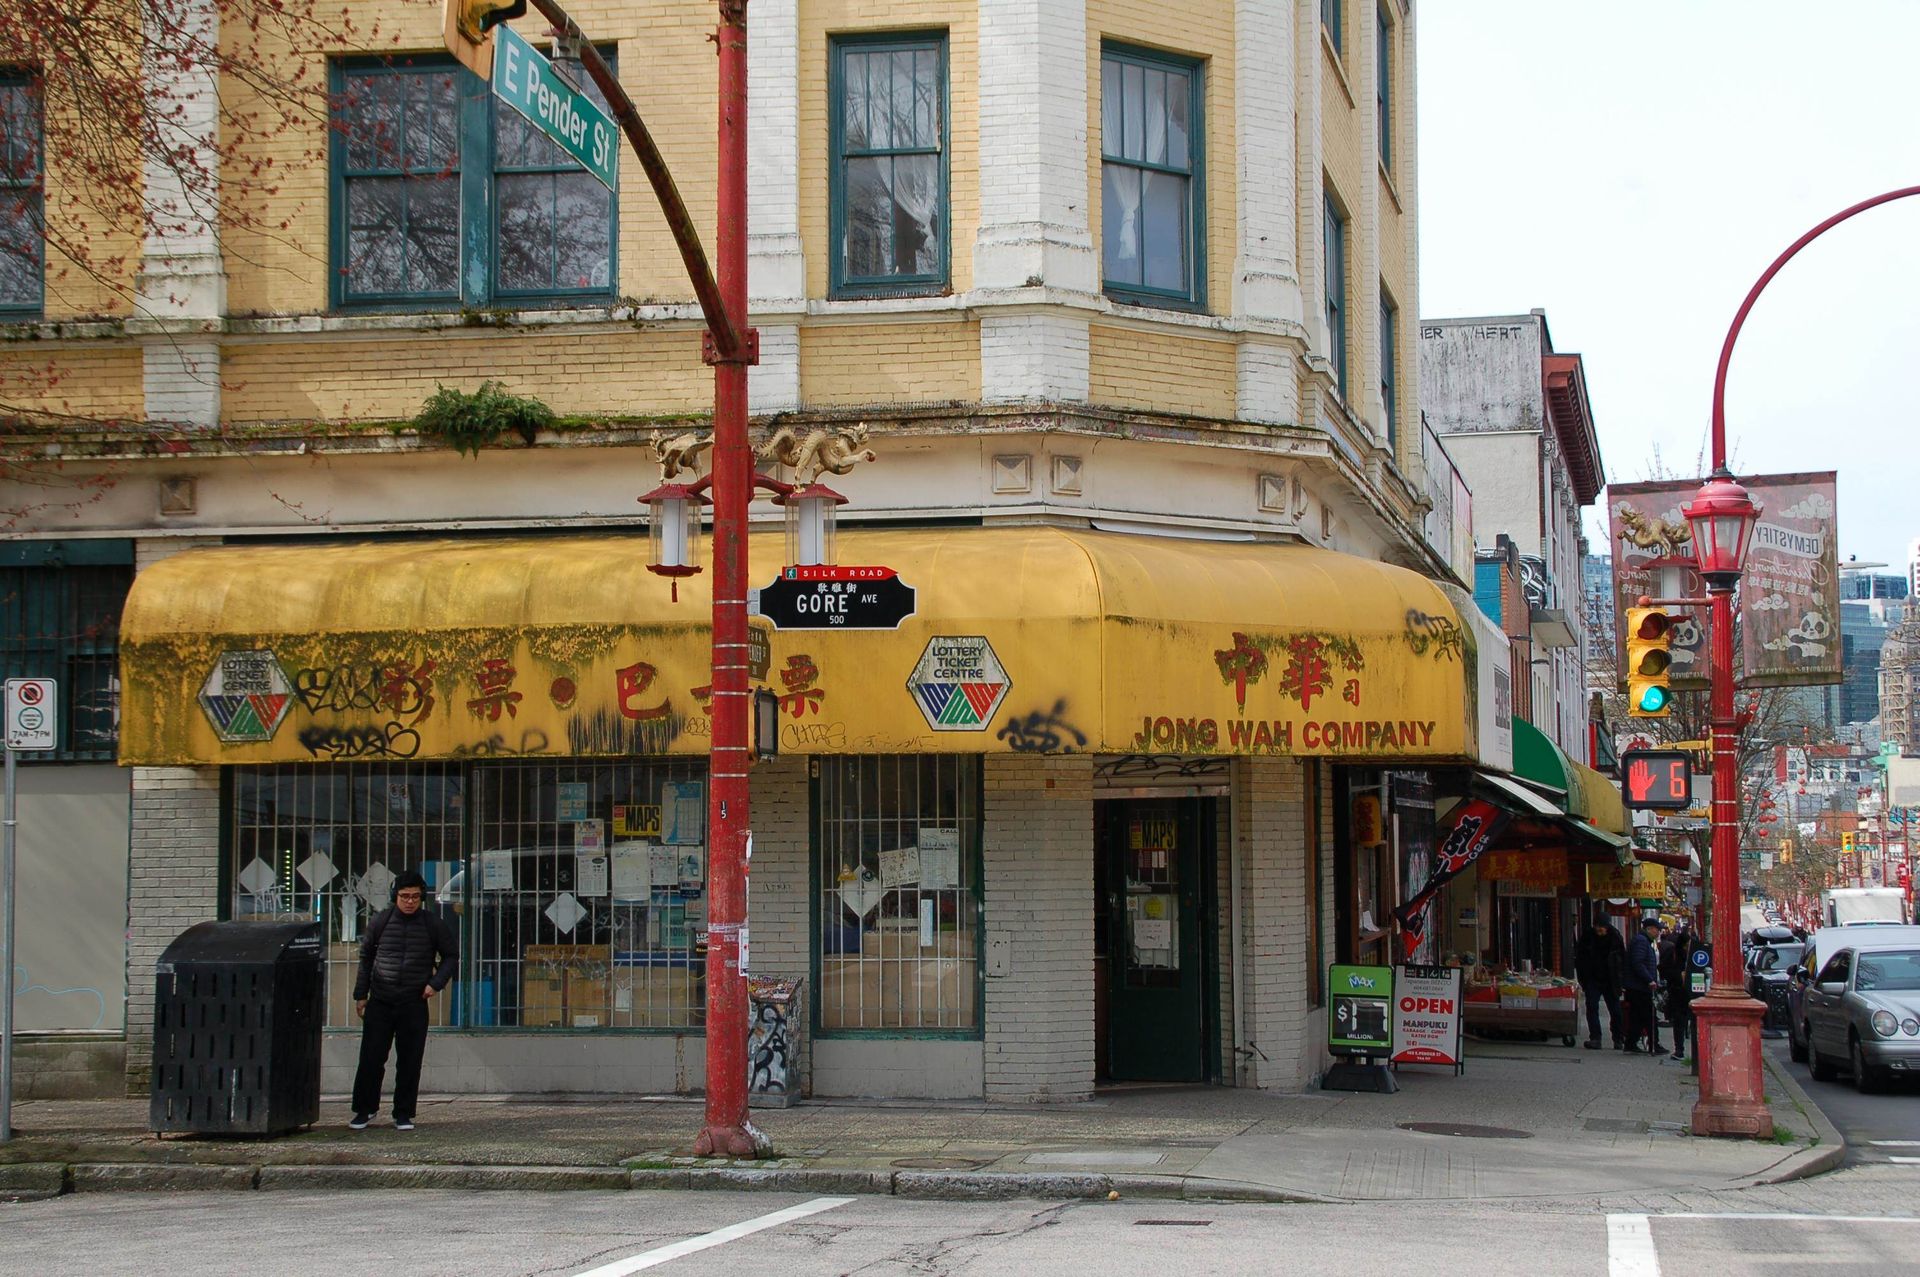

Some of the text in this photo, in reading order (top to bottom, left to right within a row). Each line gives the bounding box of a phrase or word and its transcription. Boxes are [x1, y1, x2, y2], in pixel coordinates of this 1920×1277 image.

[504, 40, 610, 172] E Pender St
[796, 594, 878, 613] GORE AVE
[829, 615, 845, 625] 500
[932, 646, 984, 657] LOTTERY
[222, 660, 270, 669] LOTTERY
[937, 657, 979, 667] TICKET
[227, 671, 266, 680] TICKET
[934, 669, 984, 678] CENTRE
[223, 681, 271, 690] CENTRE
[1134, 716, 1436, 750] JONG WAH COMPANY
[1669, 762, 1686, 798] 6
[625, 806, 660, 832] MAPS
[1142, 821, 1174, 849] MAPS
[1697, 953, 1705, 964] P
[1349, 975, 1375, 988] MAX
[1399, 996, 1454, 1015] OPEN
[1402, 1019, 1449, 1029] MANPUKU
